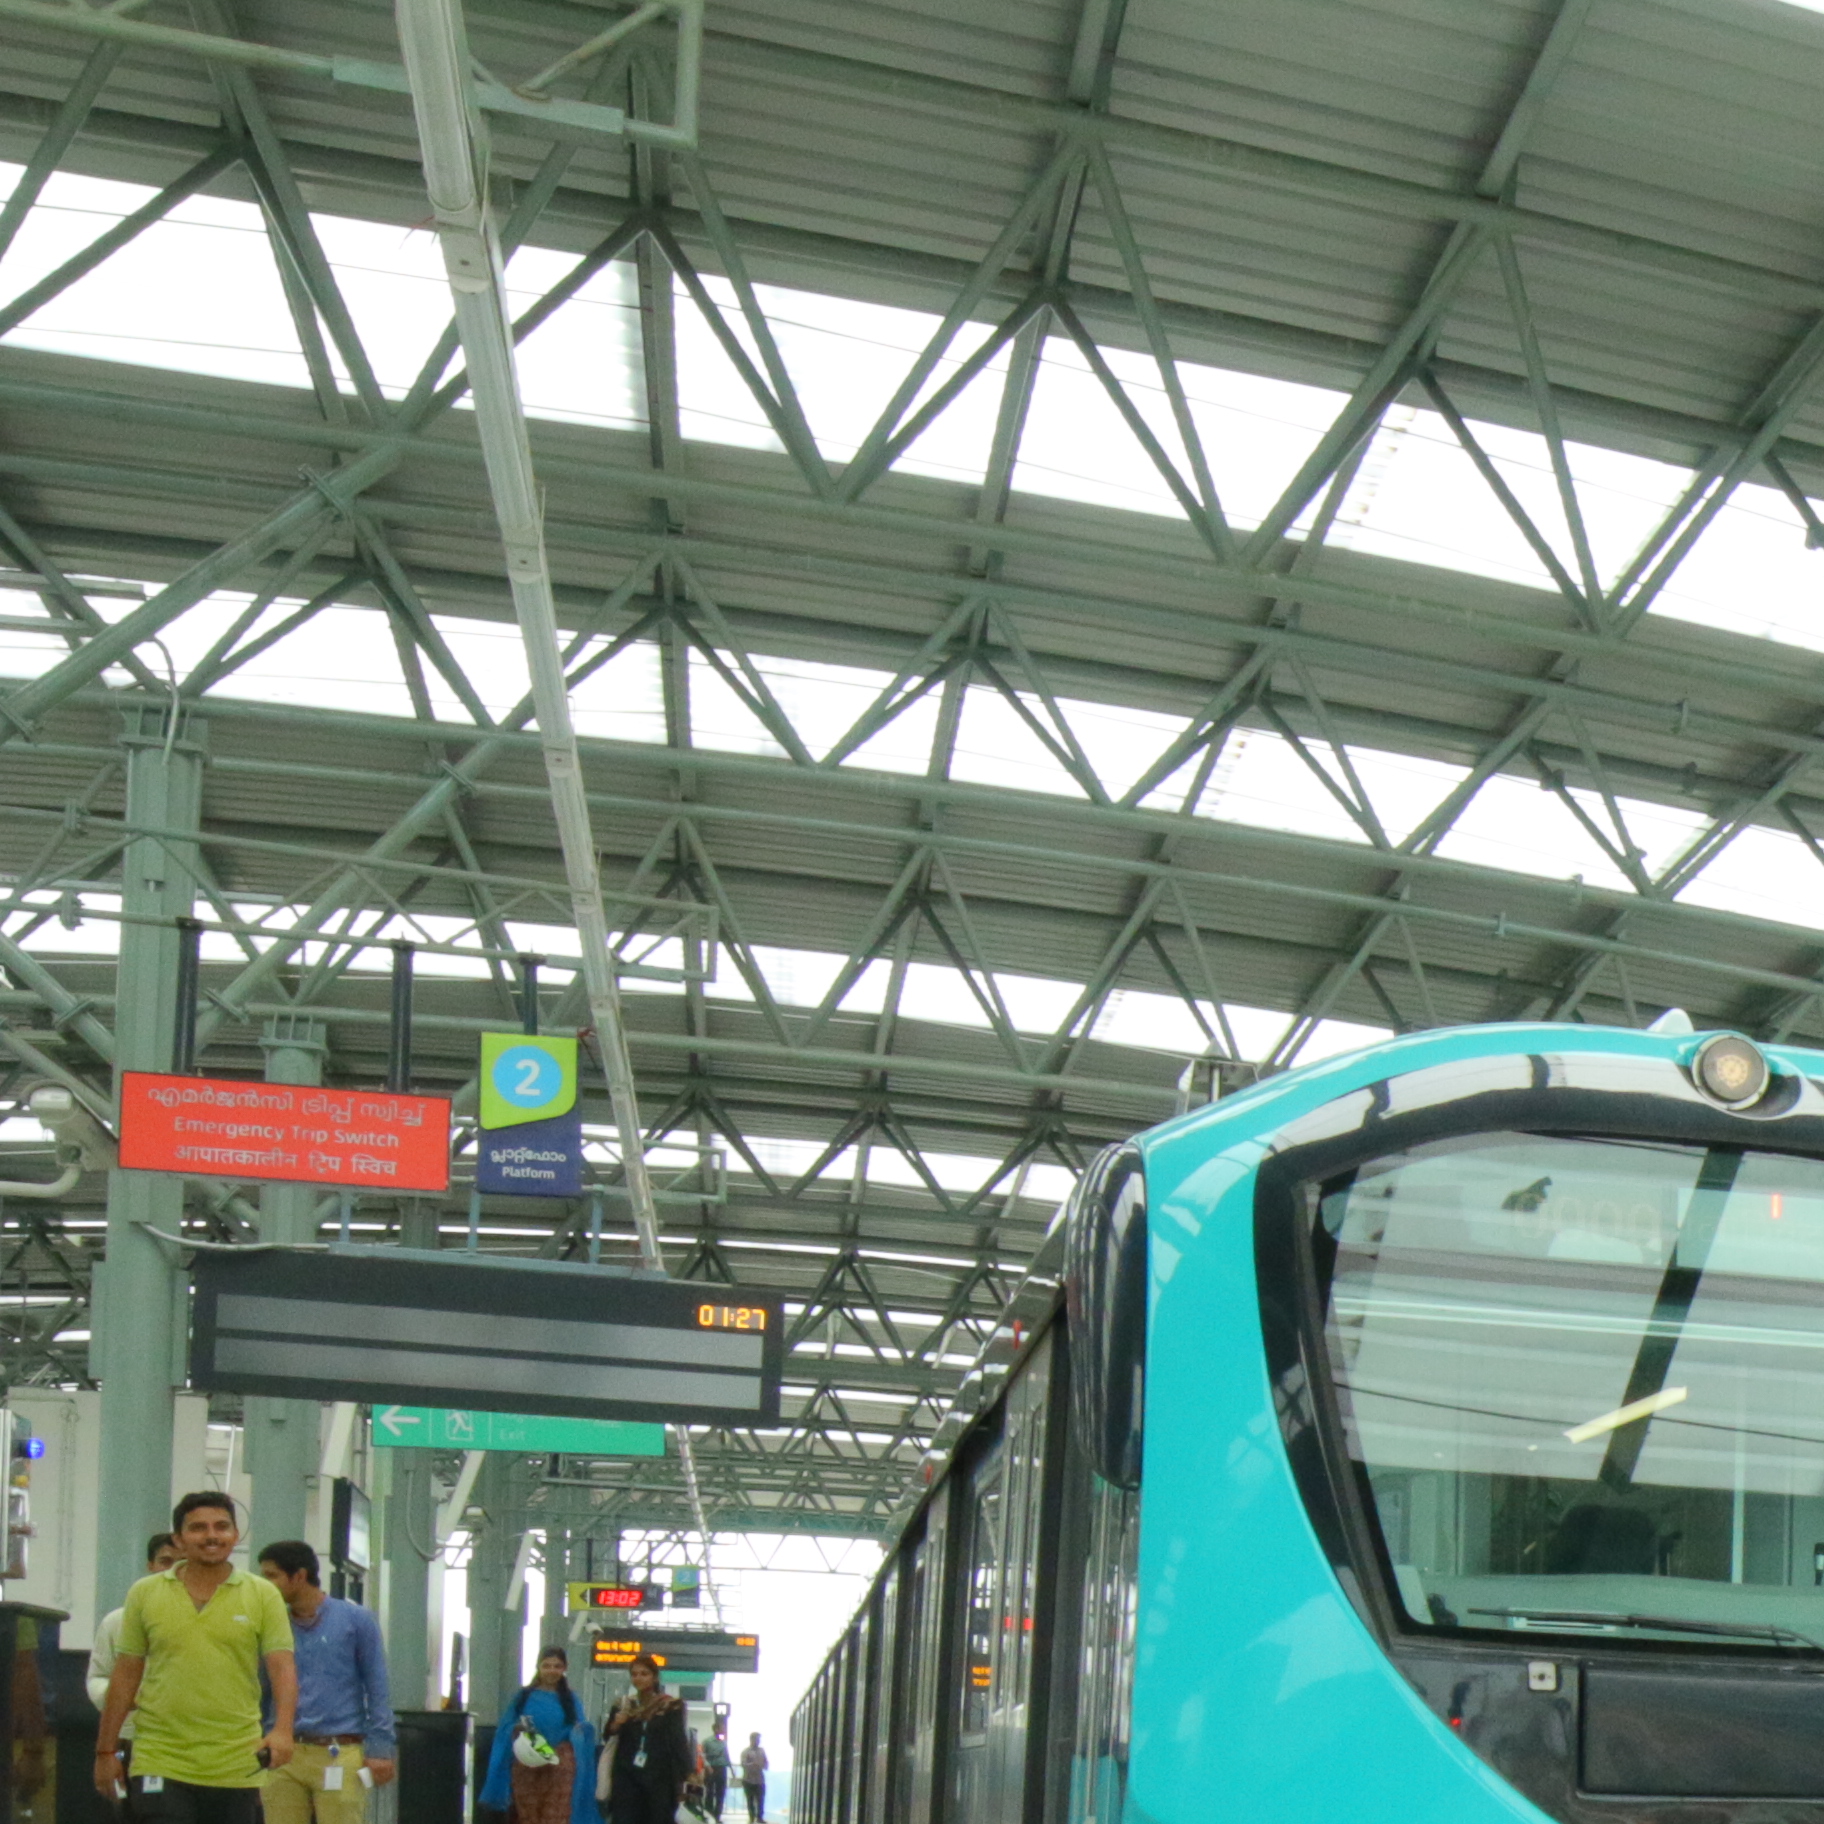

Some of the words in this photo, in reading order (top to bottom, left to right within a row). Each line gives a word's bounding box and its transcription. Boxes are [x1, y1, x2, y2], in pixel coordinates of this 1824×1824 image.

[514, 1059, 541, 1096] 2
[174, 1116, 284, 1140] Emergency
[292, 1126, 328, 1144] Trip
[334, 1129, 400, 1147] Switch
[502, 1166, 555, 1179] Platform
[698, 1304, 766, 1331] 01:27
[597, 1590, 643, 1607] 13:02
